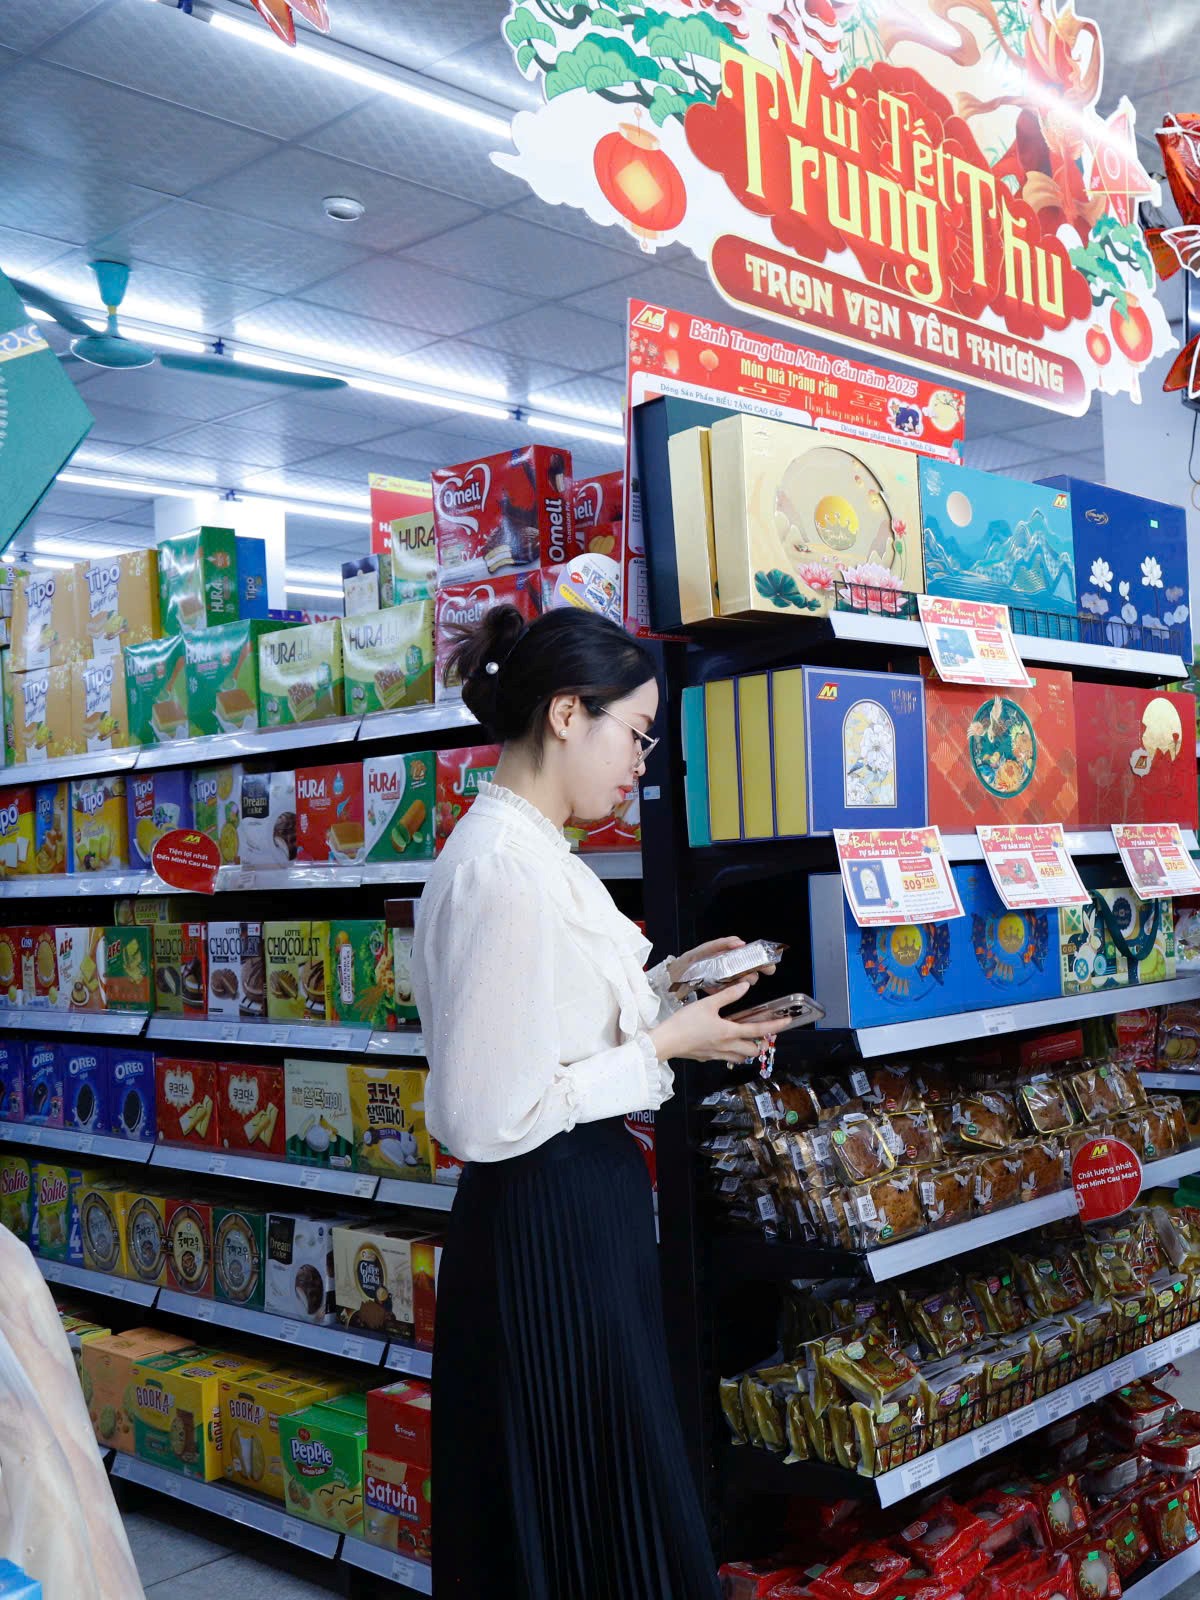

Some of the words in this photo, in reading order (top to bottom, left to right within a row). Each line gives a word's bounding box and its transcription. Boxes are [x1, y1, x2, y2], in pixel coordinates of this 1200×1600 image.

[776, 37, 860, 152] Vui
[879, 92, 950, 211] Tết
[720, 44, 942, 302] Trung
[951, 158, 1065, 320] Thu
[744, 253, 833, 316] TRỌN
[843, 286, 901, 339] VẸN
[909, 312, 959, 360] YÊU
[966, 331, 1064, 394] THƯƠNG
[689, 319, 730, 348] Bánh
[731, 330, 770, 361] Trung
[771, 344, 796, 366] thu
[797, 349, 830, 376] Minh
[831, 357, 858, 383] Cầu
[857, 368, 886, 389] năm
[886, 375, 918, 398] 2025
[741, 358, 763, 379] Món
[766, 367, 785, 385] quà
[787, 370, 816, 394] Trăng
[818, 376, 838, 398] rằm
[754, 406, 768, 415] CAO
[443, 482, 481, 507] Omeli
[545, 499, 565, 562] Omeli
[84, 564, 120, 593] Tipo
[246, 576, 258, 600] Tipo
[25, 579, 55, 606] Tipo
[211, 581, 225, 612] HURA
[349, 626, 383, 650] HURA
[265, 641, 296, 665] HURA
[22, 678, 48, 704] Tipo
[82, 665, 113, 693] Tipo
[133, 780, 153, 798] Tipo
[195, 780, 217, 802] Tipo
[297, 778, 325, 799] HURA
[368, 771, 397, 794] HURA
[81, 792, 104, 816] Tipo
[242, 796, 268, 807] Dream
[171, 856, 187, 865] Minh
[904, 879, 922, 890] 309
[284, 929, 301, 937] LOTTE
[59, 937, 73, 957] AFC
[107, 940, 121, 960] AFC
[267, 937, 320, 956] CHOCOLAT
[32, 1052, 55, 1068] OREO
[69, 1056, 97, 1075] OREO
[115, 1062, 144, 1080] OREO
[168, 1081, 191, 1096] 쿠크다스
[232, 1087, 255, 1101] 쿠크다스
[367, 1082, 401, 1106] 코코넛
[366, 1104, 405, 1128] 찰떡파이
[1, 1169, 29, 1196] Solite
[1076, 1181, 1089, 1190] Đến
[1090, 1177, 1106, 1187] Minh
[1121, 1171, 1138, 1181] Mart
[1078, 1169, 1093, 1180] Chất
[1094, 1165, 1114, 1178] lượng
[1115, 1161, 1132, 1172] nhất
[40, 1179, 67, 1206] Solite
[270, 1238, 291, 1251] Dream
[136, 1386, 170, 1416] GOOKA
[229, 1400, 262, 1425] GOOKA
[367, 1476, 417, 1514] Saturn
